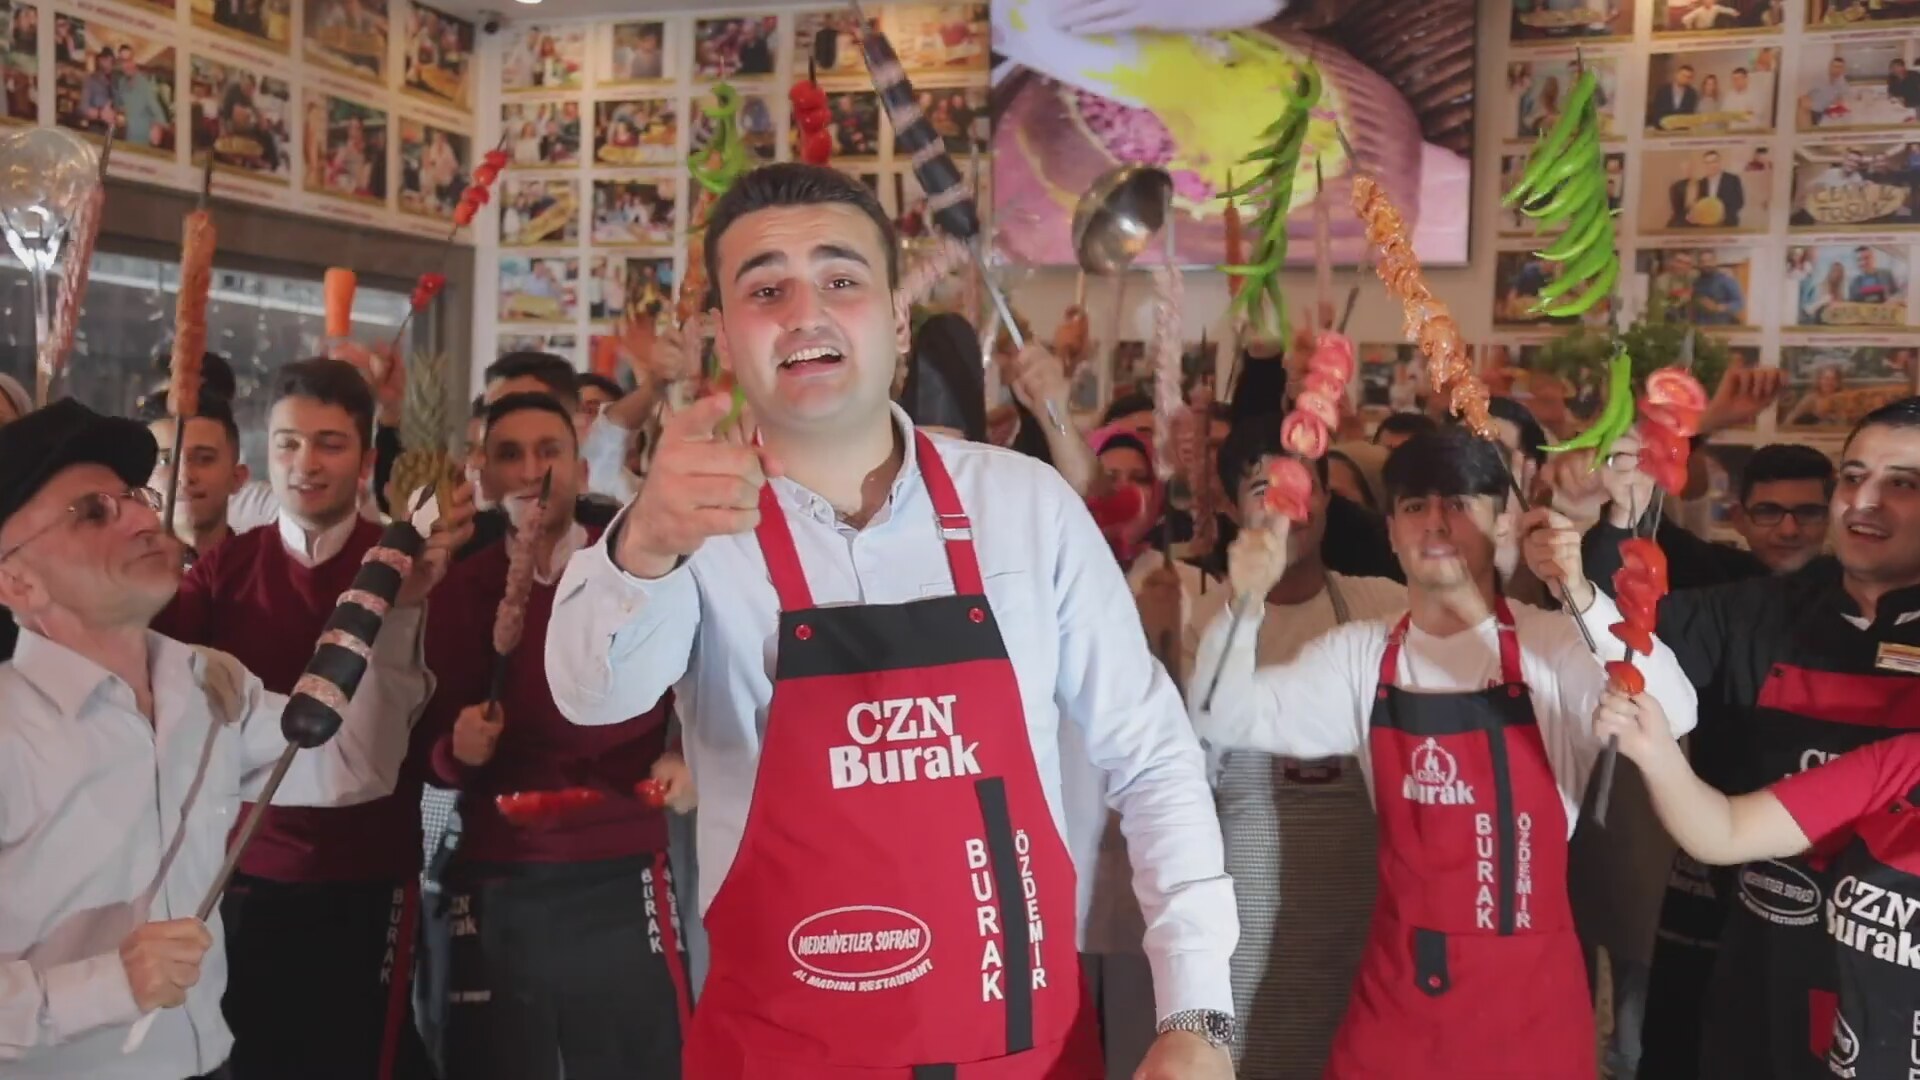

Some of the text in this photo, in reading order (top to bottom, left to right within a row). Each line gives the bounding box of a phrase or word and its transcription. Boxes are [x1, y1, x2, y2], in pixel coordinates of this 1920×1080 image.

[846, 695, 957, 746] CZN
[828, 735, 983, 790] Burak
[1475, 813, 1495, 929] BURAK
[641, 867, 664, 954] BURAK
[965, 838, 1004, 1003] BURAK
[1014, 829, 1048, 990] ÖZDEMİR
[1833, 875, 1920, 930] CZN
[874, 927, 921, 951] SOFRASI
[792, 958, 934, 992] AL MADINA RESTAURANT
